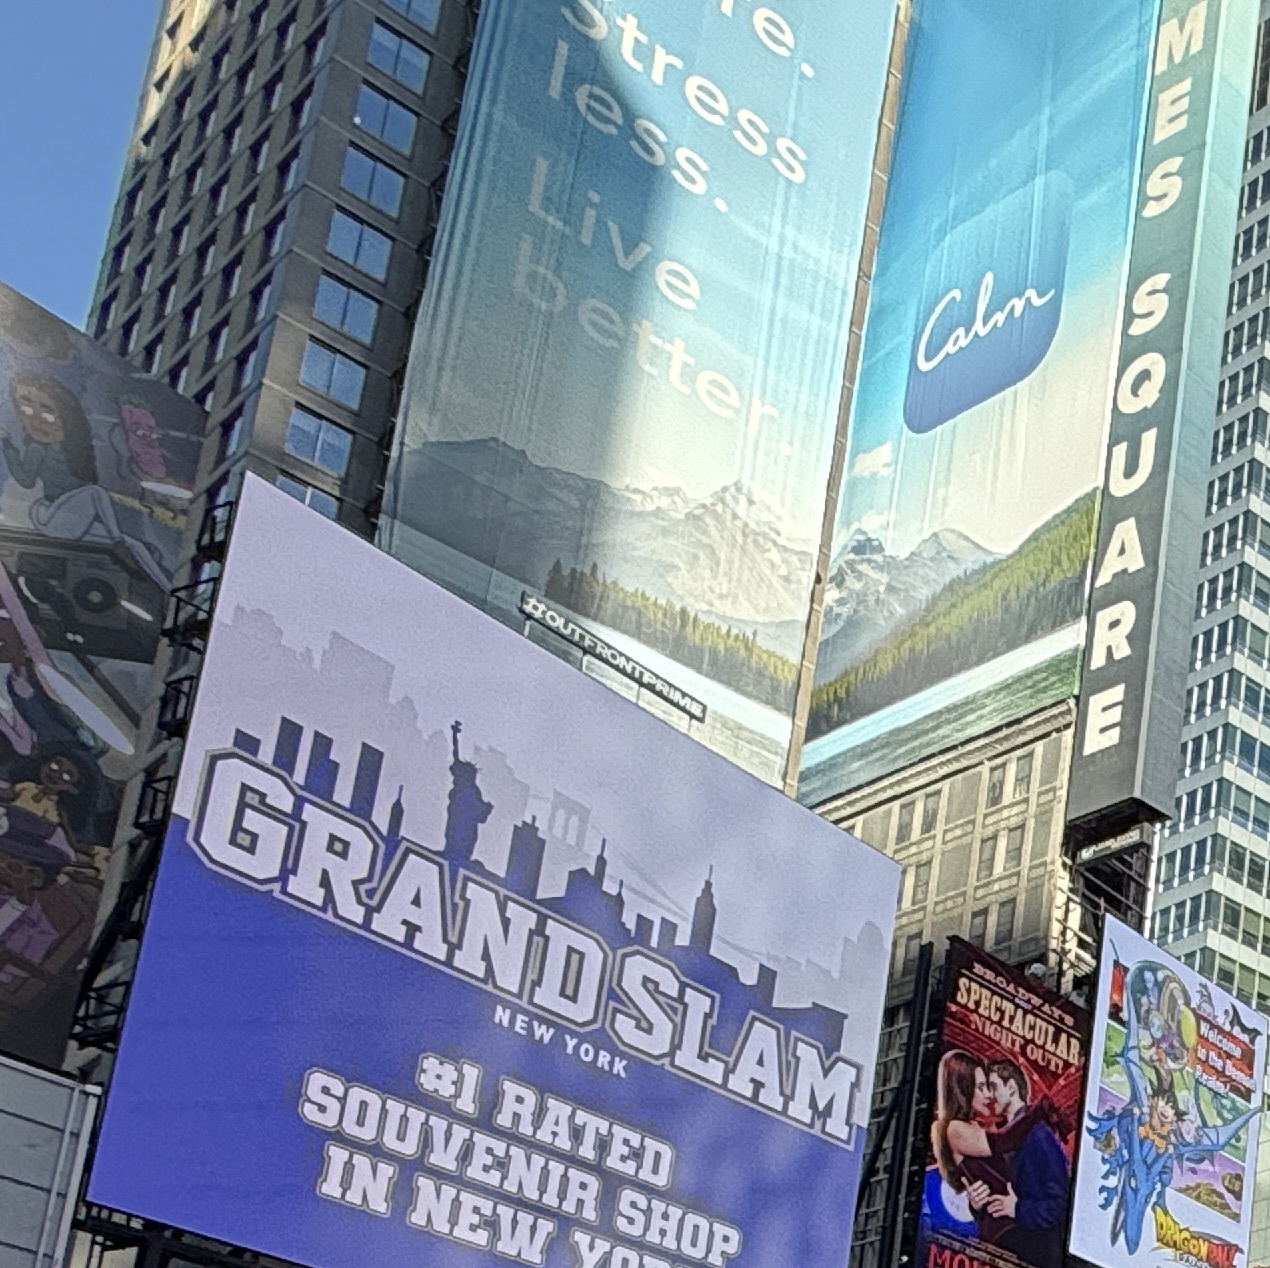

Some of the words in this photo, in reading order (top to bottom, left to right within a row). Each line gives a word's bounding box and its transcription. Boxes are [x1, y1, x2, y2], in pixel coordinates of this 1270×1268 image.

[548, 38, 729, 213] less.
[528, 156, 701, 311] Live
[510, 234, 792, 456] better.
[915, 271, 1056, 372] Calm
[1082, 272, 1172, 757] SQUARE
[494, 1005, 556, 1046] NEW
[563, 1033, 629, 1079] YORK
[957, 976, 1082, 1066] SPECTACULAR
[970, 1012, 1025, 1053] NIGHT
[300, 1069, 602, 1226] SOUVENIR
[419, 1054, 483, 1116] #1
[499, 1078, 675, 1192] RATED
[318, 1143, 396, 1217] IN
[409, 1175, 556, 1268] NEW
[1152, 1204, 1209, 1262] DRAGON
